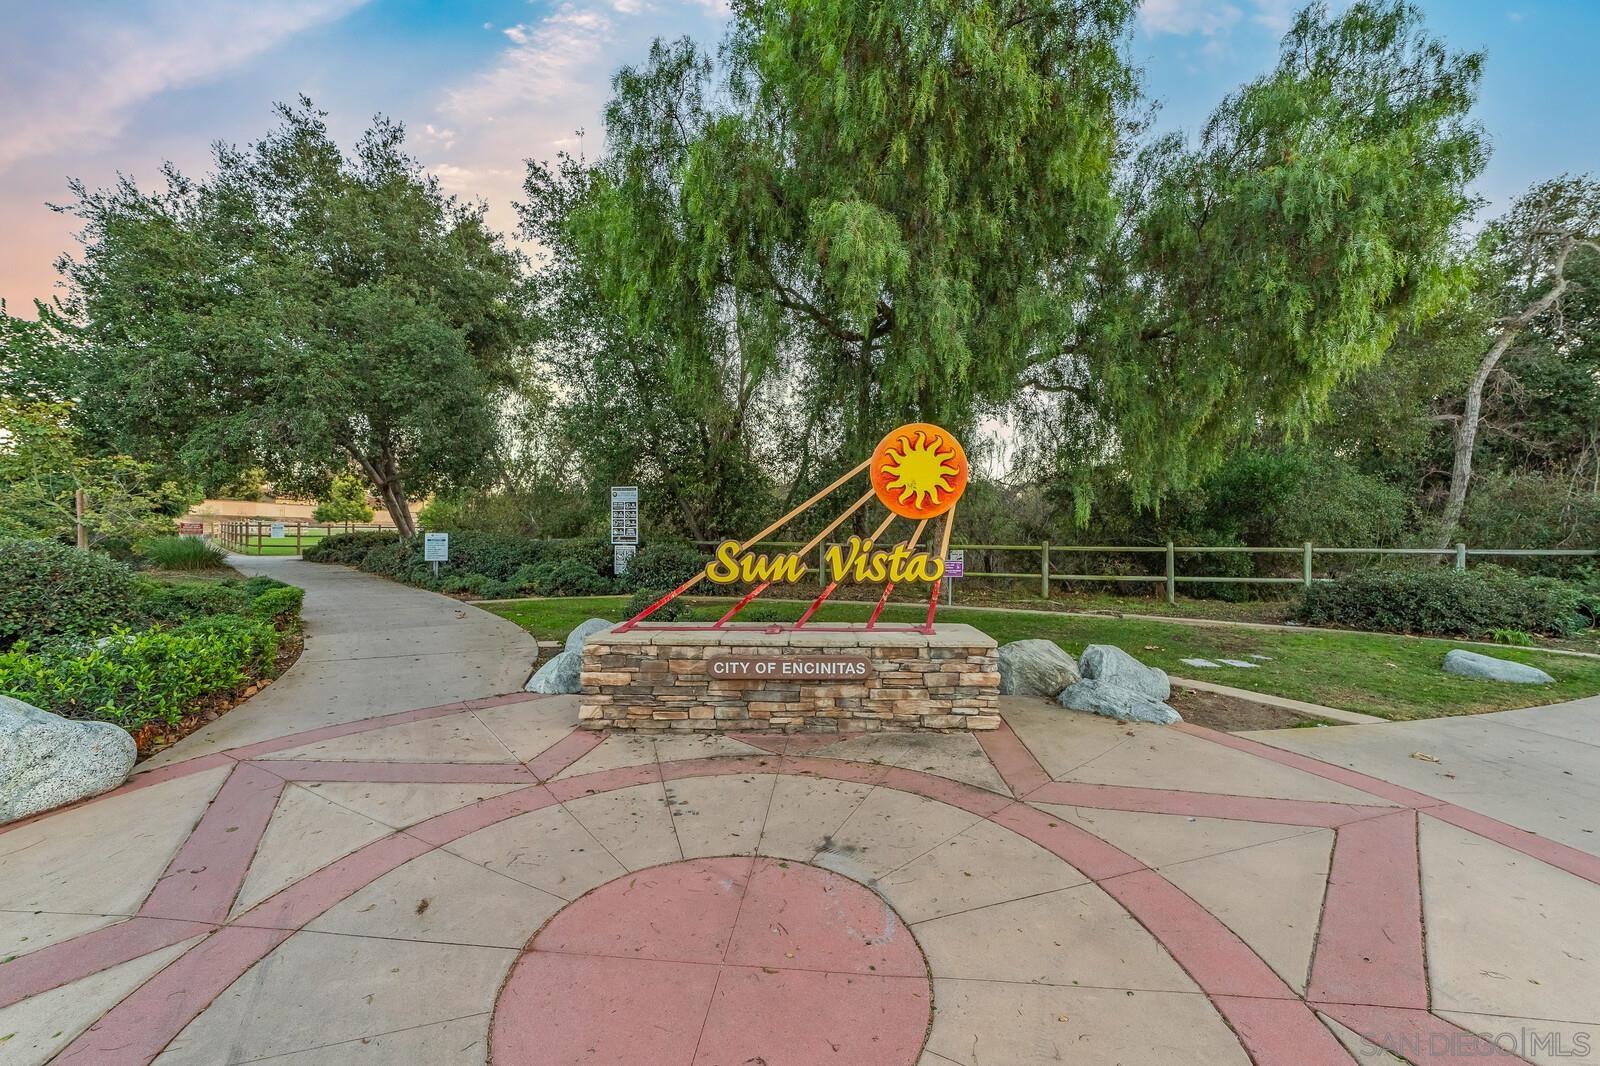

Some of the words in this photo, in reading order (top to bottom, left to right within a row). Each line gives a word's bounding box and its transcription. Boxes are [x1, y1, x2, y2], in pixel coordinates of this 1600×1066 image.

[704, 539, 808, 584] Sun
[825, 535, 946, 583] Vista
[713, 662, 750, 674] CITY
[755, 662, 777, 674] OF
[782, 662, 866, 674] ENCINITAS
